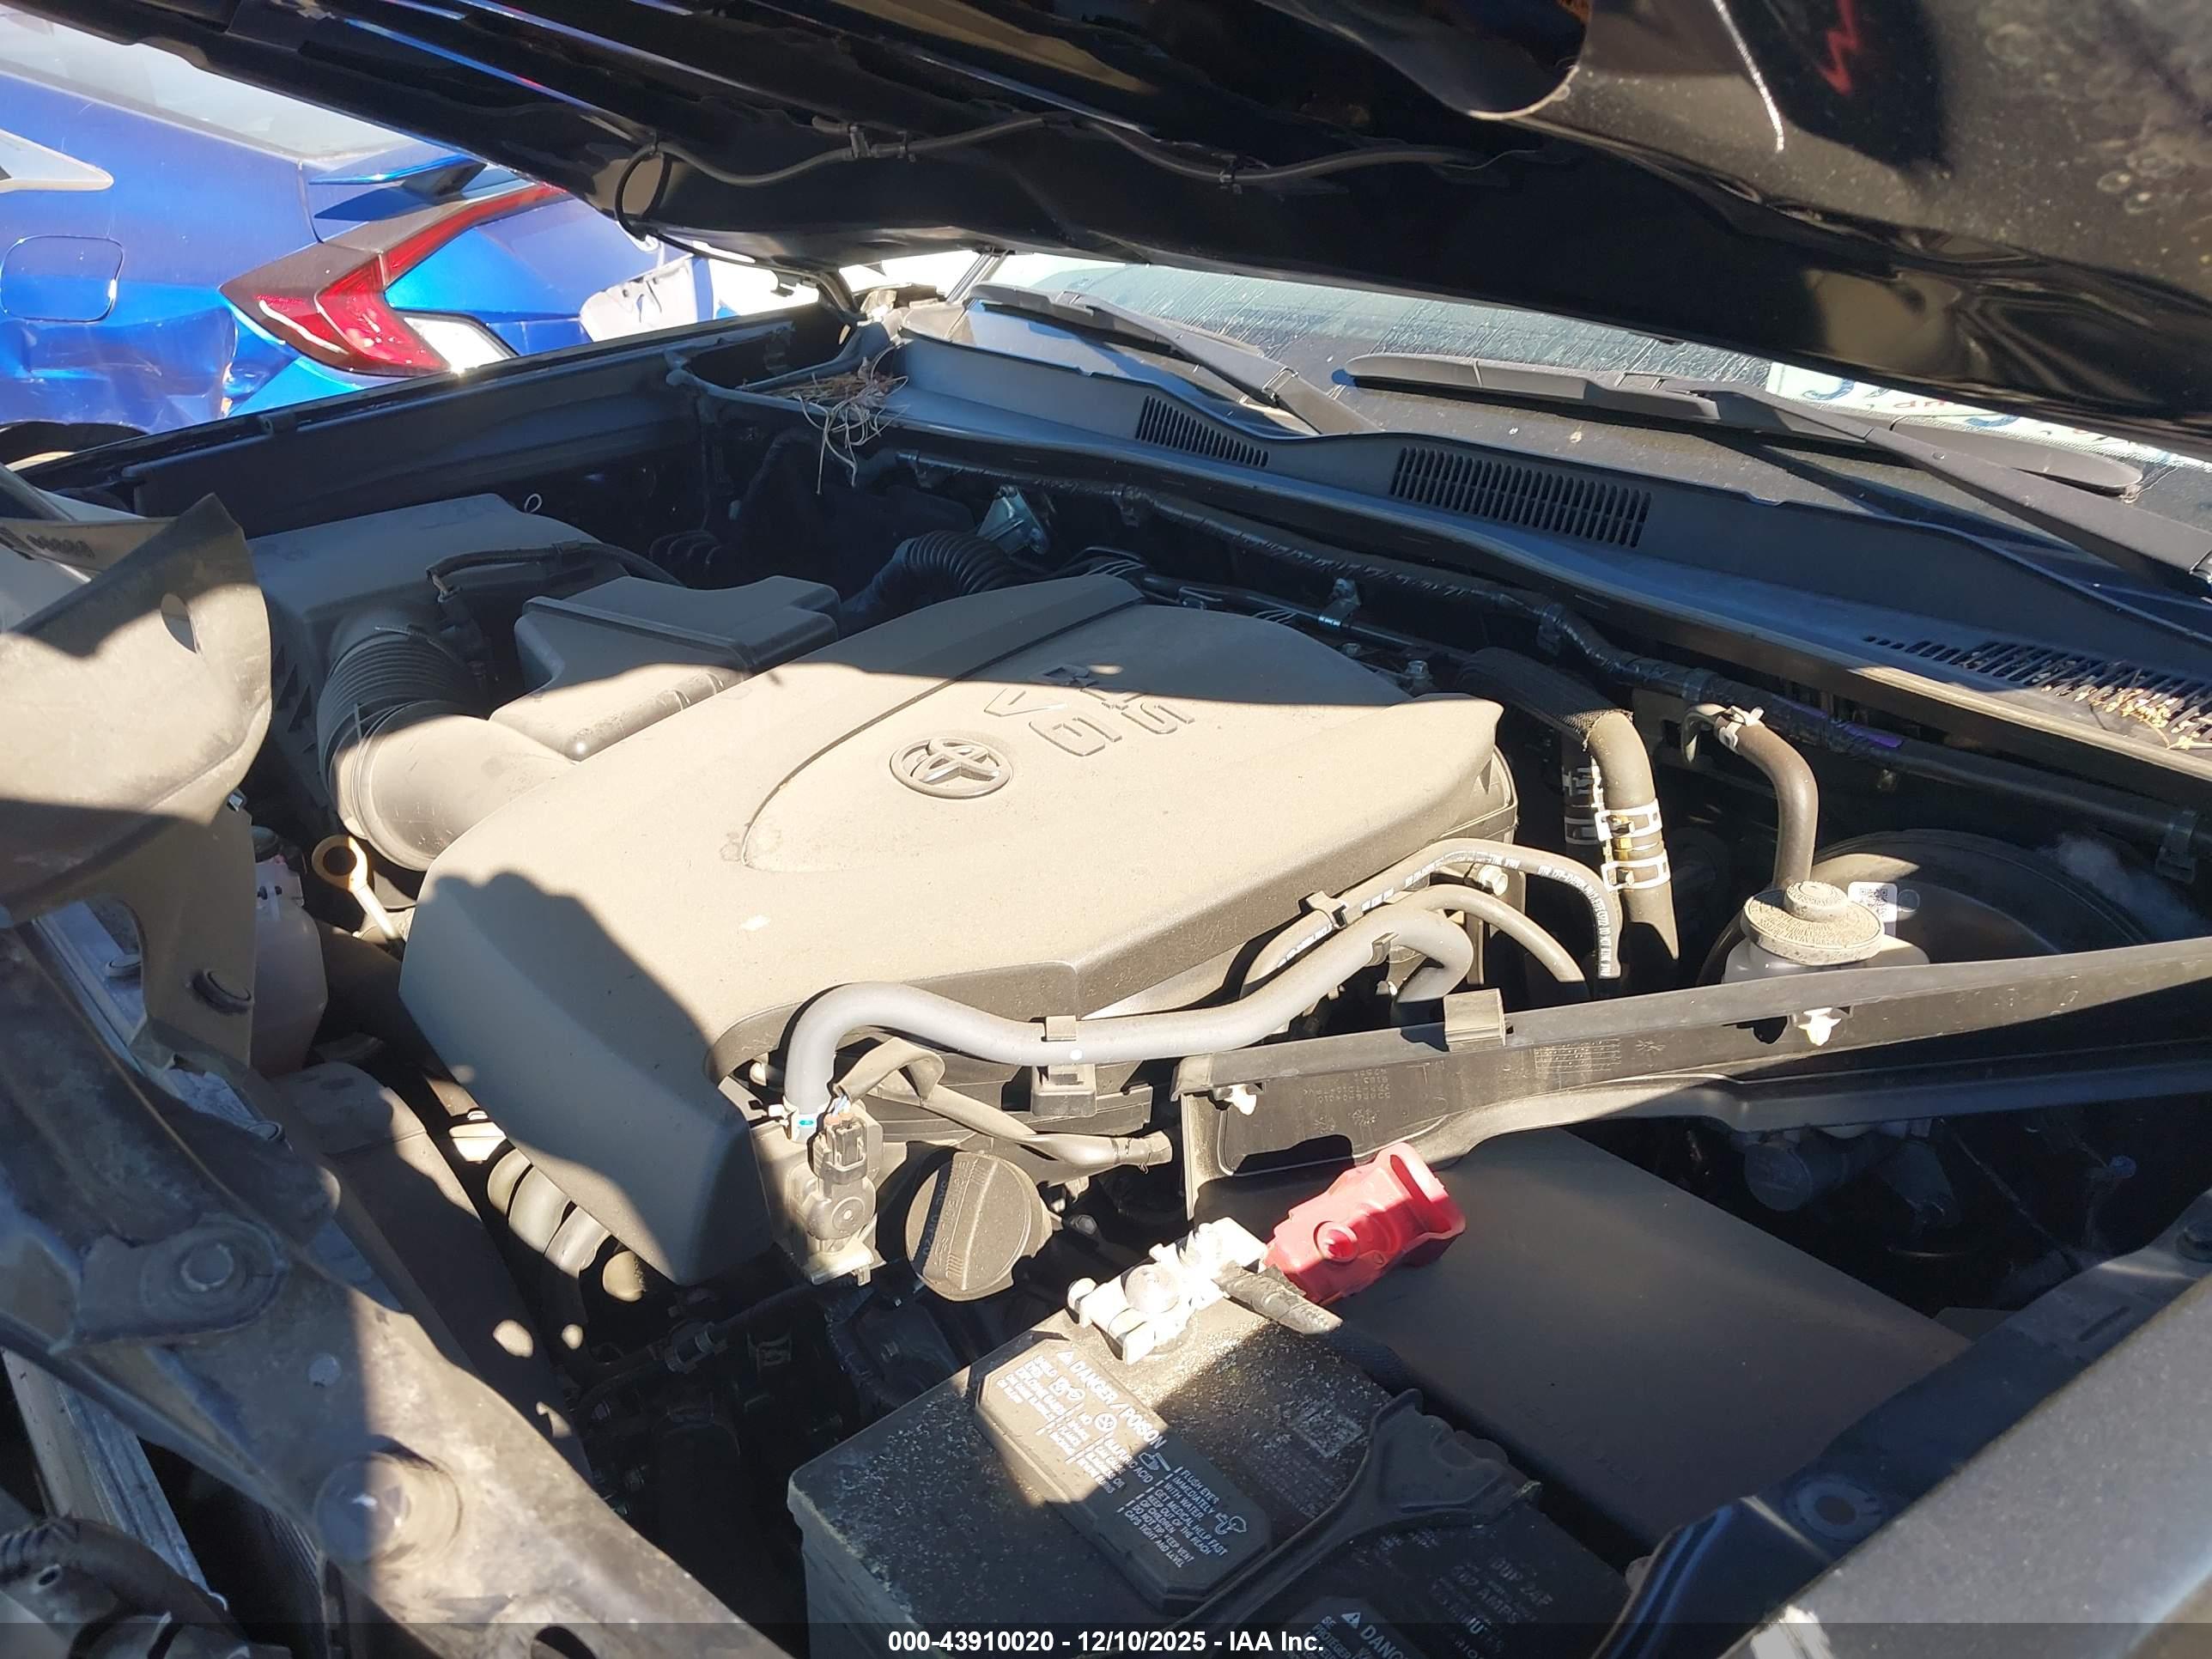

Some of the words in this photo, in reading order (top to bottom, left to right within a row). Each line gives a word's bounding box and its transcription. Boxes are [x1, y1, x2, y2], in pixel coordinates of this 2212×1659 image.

[983, 685, 1123, 757] V6
[1077, 1412, 1093, 1425] NO
[1103, 1437, 1139, 1469] SULFURIC
[1133, 1465, 1154, 1484] ACID
[1163, 1482, 1182, 1498] WITH
[1171, 1475, 1215, 1515] IMMEDIATELY
[1181, 1469, 1203, 1489] FLUSH
[1200, 1487, 1219, 1504] EYES
[1131, 1504, 1144, 1515] DO
[1139, 1512, 1155, 1526] NOT
[1162, 1534, 1179, 1548] KEEP
[1176, 1547, 1194, 1563] VENT
[1139, 1499, 1150, 1510] OF
[1146, 1507, 1176, 1533] CHILDREN
[1146, 1494, 1163, 1509] KEEP
[1159, 1506, 1174, 1519] OUT
[1171, 1517, 1182, 1527] OF
[1180, 1526, 1194, 1538] THE
[1153, 1488, 1170, 1503] GET
[1166, 1500, 1195, 1526] MEDICAL
[1192, 1524, 1211, 1540] HELP
[1207, 1539, 1227, 1555] FAST
[1123, 1510, 1141, 1526] CAPS
[1138, 1524, 1158, 1540] TIGHT
[1153, 1539, 1169, 1552] AND
[1165, 1550, 1185, 1568] LEVEL
[1319, 1614, 1338, 1630] SE
